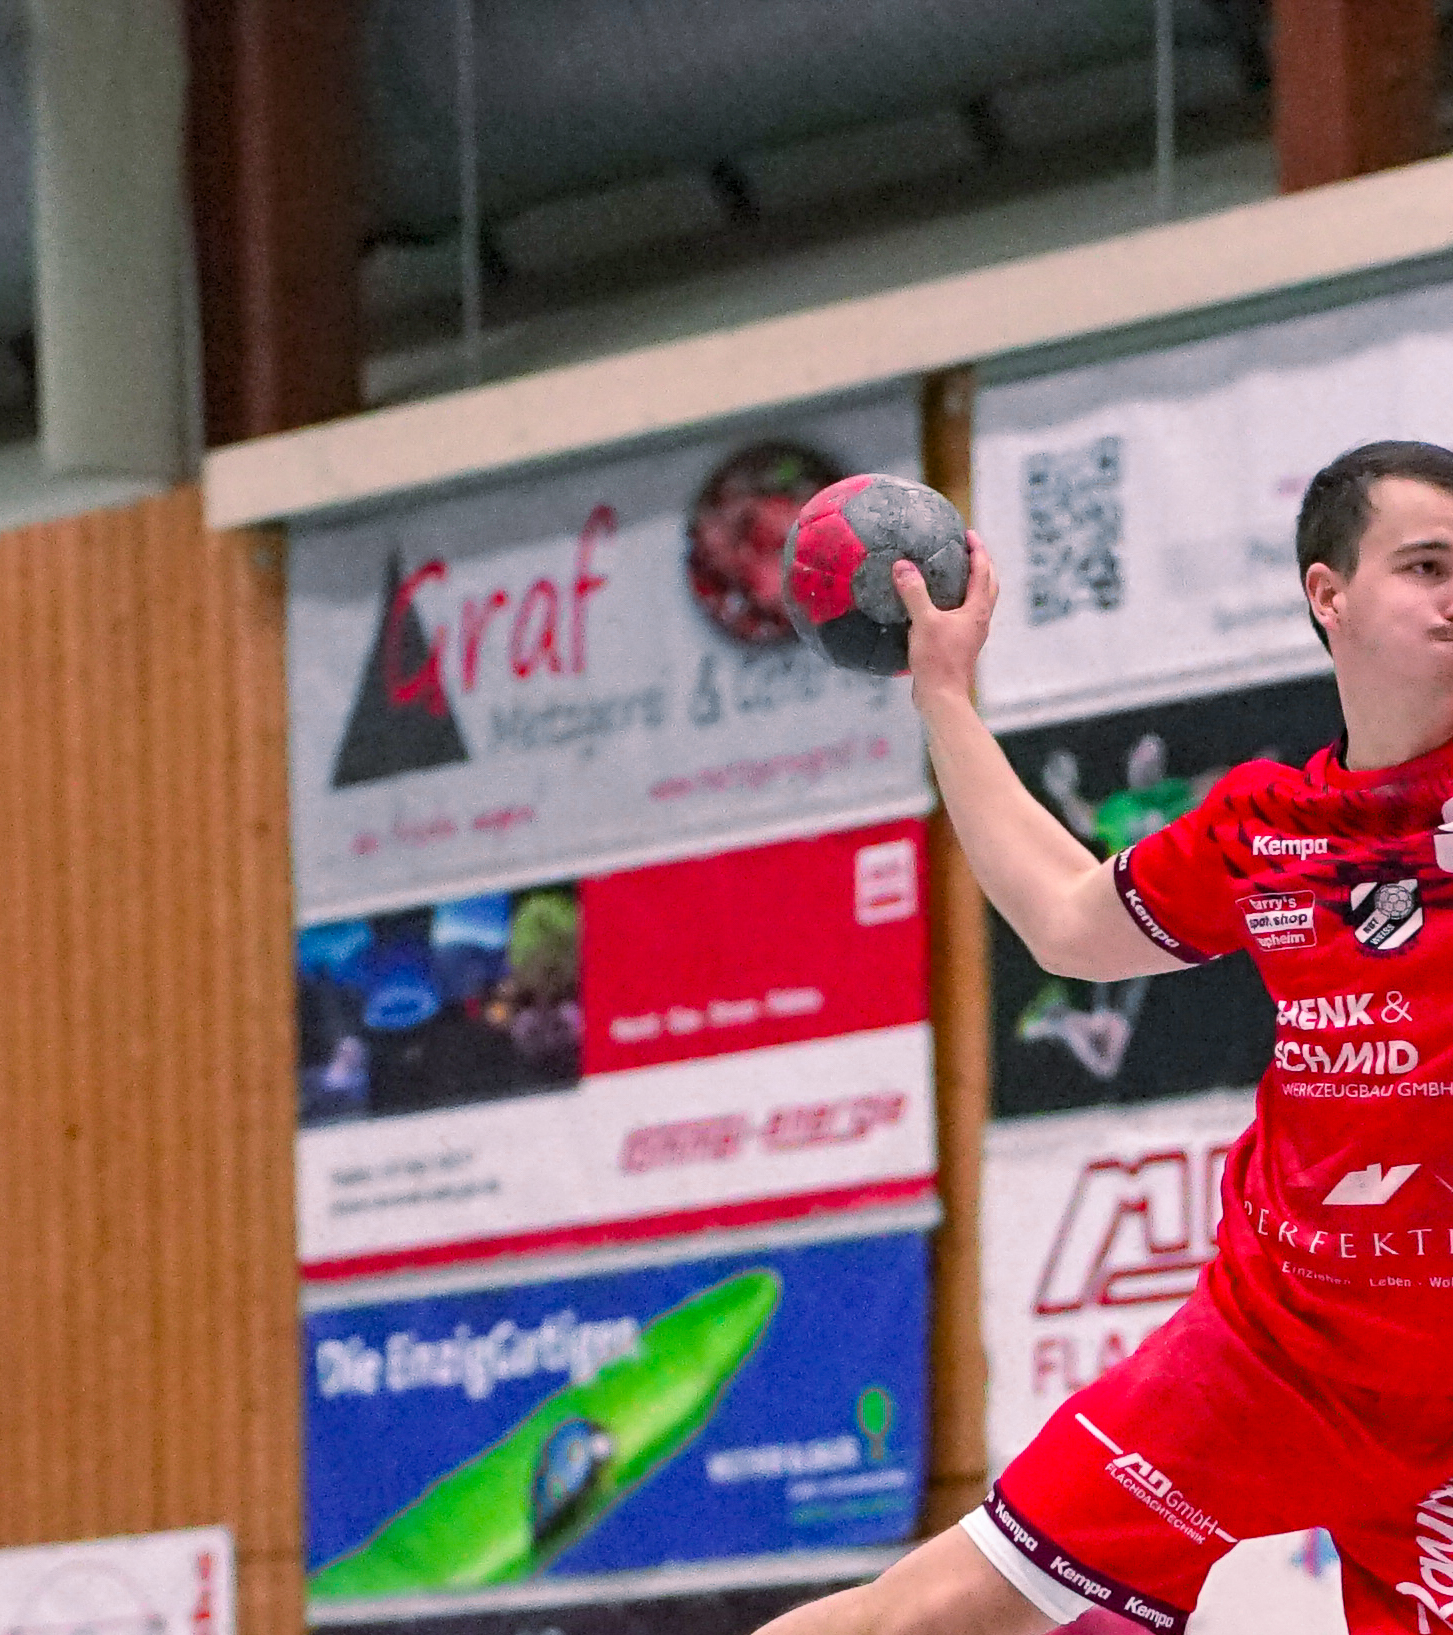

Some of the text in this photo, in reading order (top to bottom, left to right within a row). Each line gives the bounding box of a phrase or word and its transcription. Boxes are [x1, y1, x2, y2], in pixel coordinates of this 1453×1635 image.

[384, 504, 617, 718] Graf
[1252, 834, 1330, 861] Kempa
[1124, 888, 1181, 949] Kempa
[1381, 990, 1414, 1023] &
[1282, 1082, 1395, 1099] WERKZEUGBAU
[994, 1499, 1039, 1552] Kempa
[1104, 1462, 1207, 1546] FLACHDACHTECHNIK
[1165, 1489, 1219, 1536] GmbH
[1050, 1555, 1112, 1601] Kempa
[1124, 1595, 1175, 1629] Kempa
